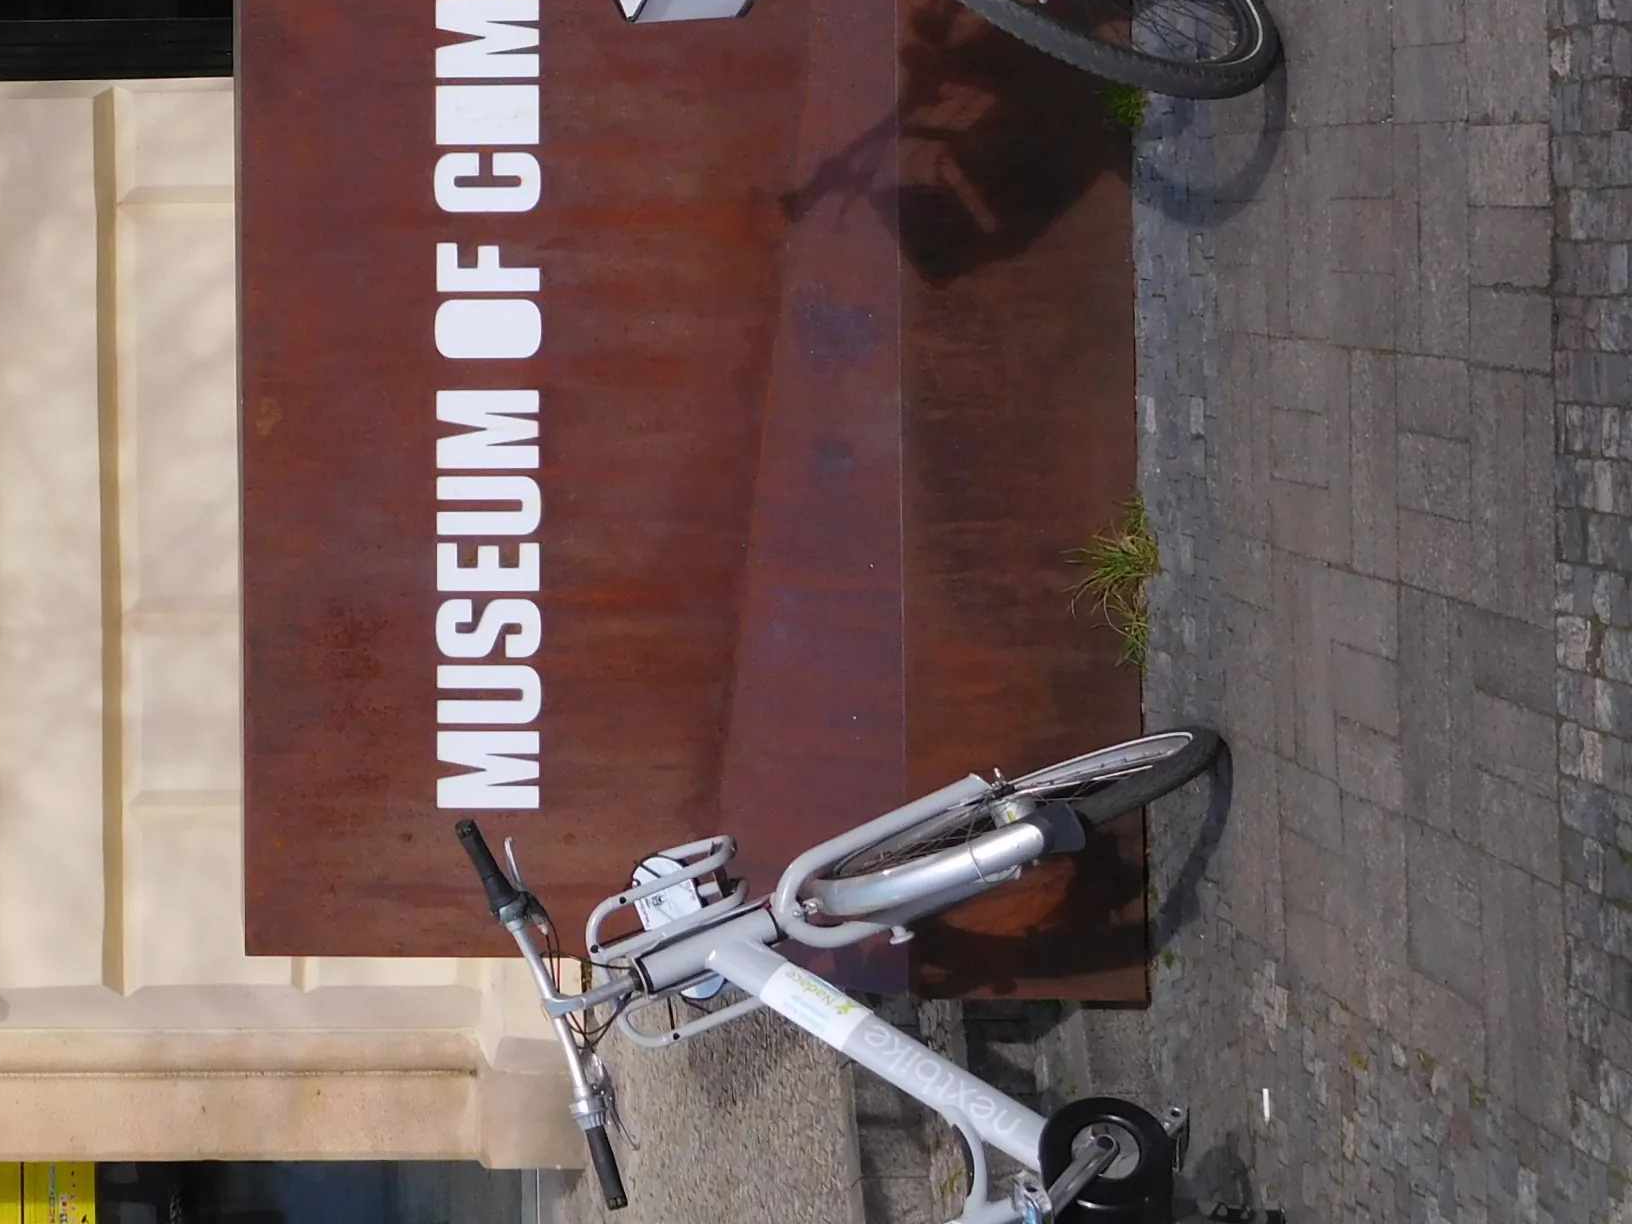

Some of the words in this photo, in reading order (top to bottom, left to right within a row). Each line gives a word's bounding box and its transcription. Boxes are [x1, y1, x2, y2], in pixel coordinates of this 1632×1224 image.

[434, 242, 542, 360] OF
[435, 389, 542, 809] MUSEUM
[863, 1024, 1022, 1136] nextbike
